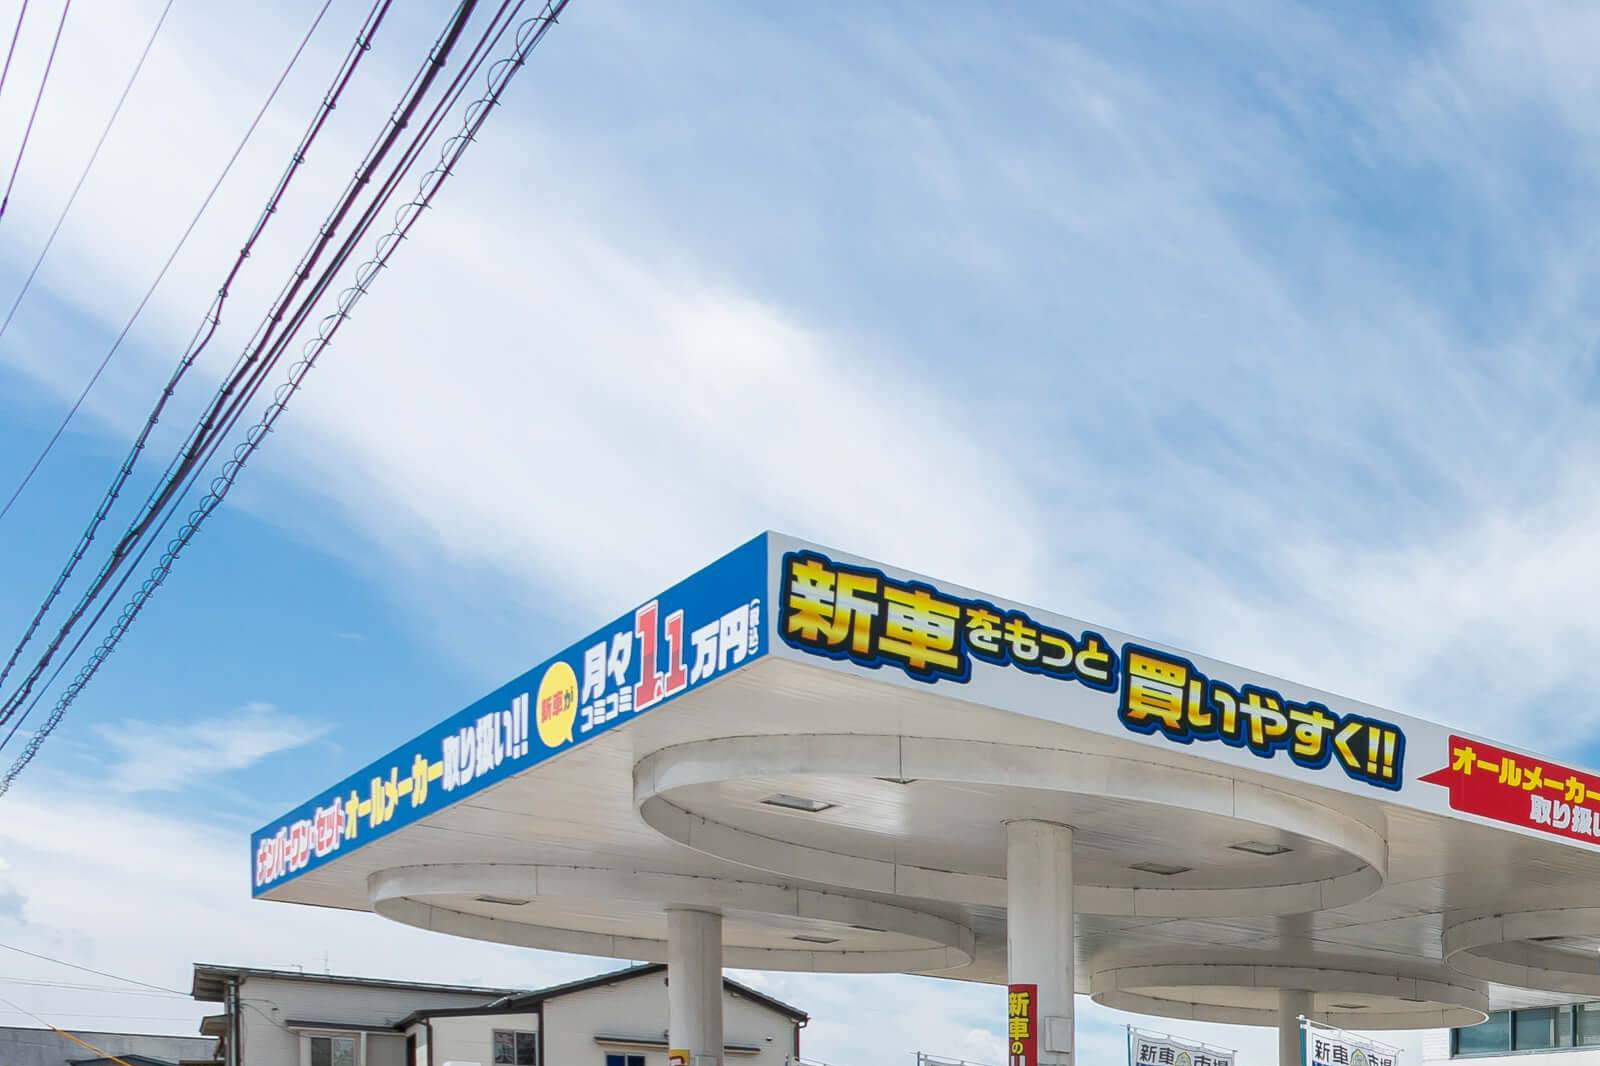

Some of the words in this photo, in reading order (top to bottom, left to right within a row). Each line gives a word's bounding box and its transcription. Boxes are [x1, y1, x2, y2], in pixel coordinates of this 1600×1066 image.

[785, 557, 1111, 684] 新車をもっと
[581, 630, 633, 705] 月々
[541, 685, 575, 724] 新車が
[580, 686, 633, 733] コミコミ
